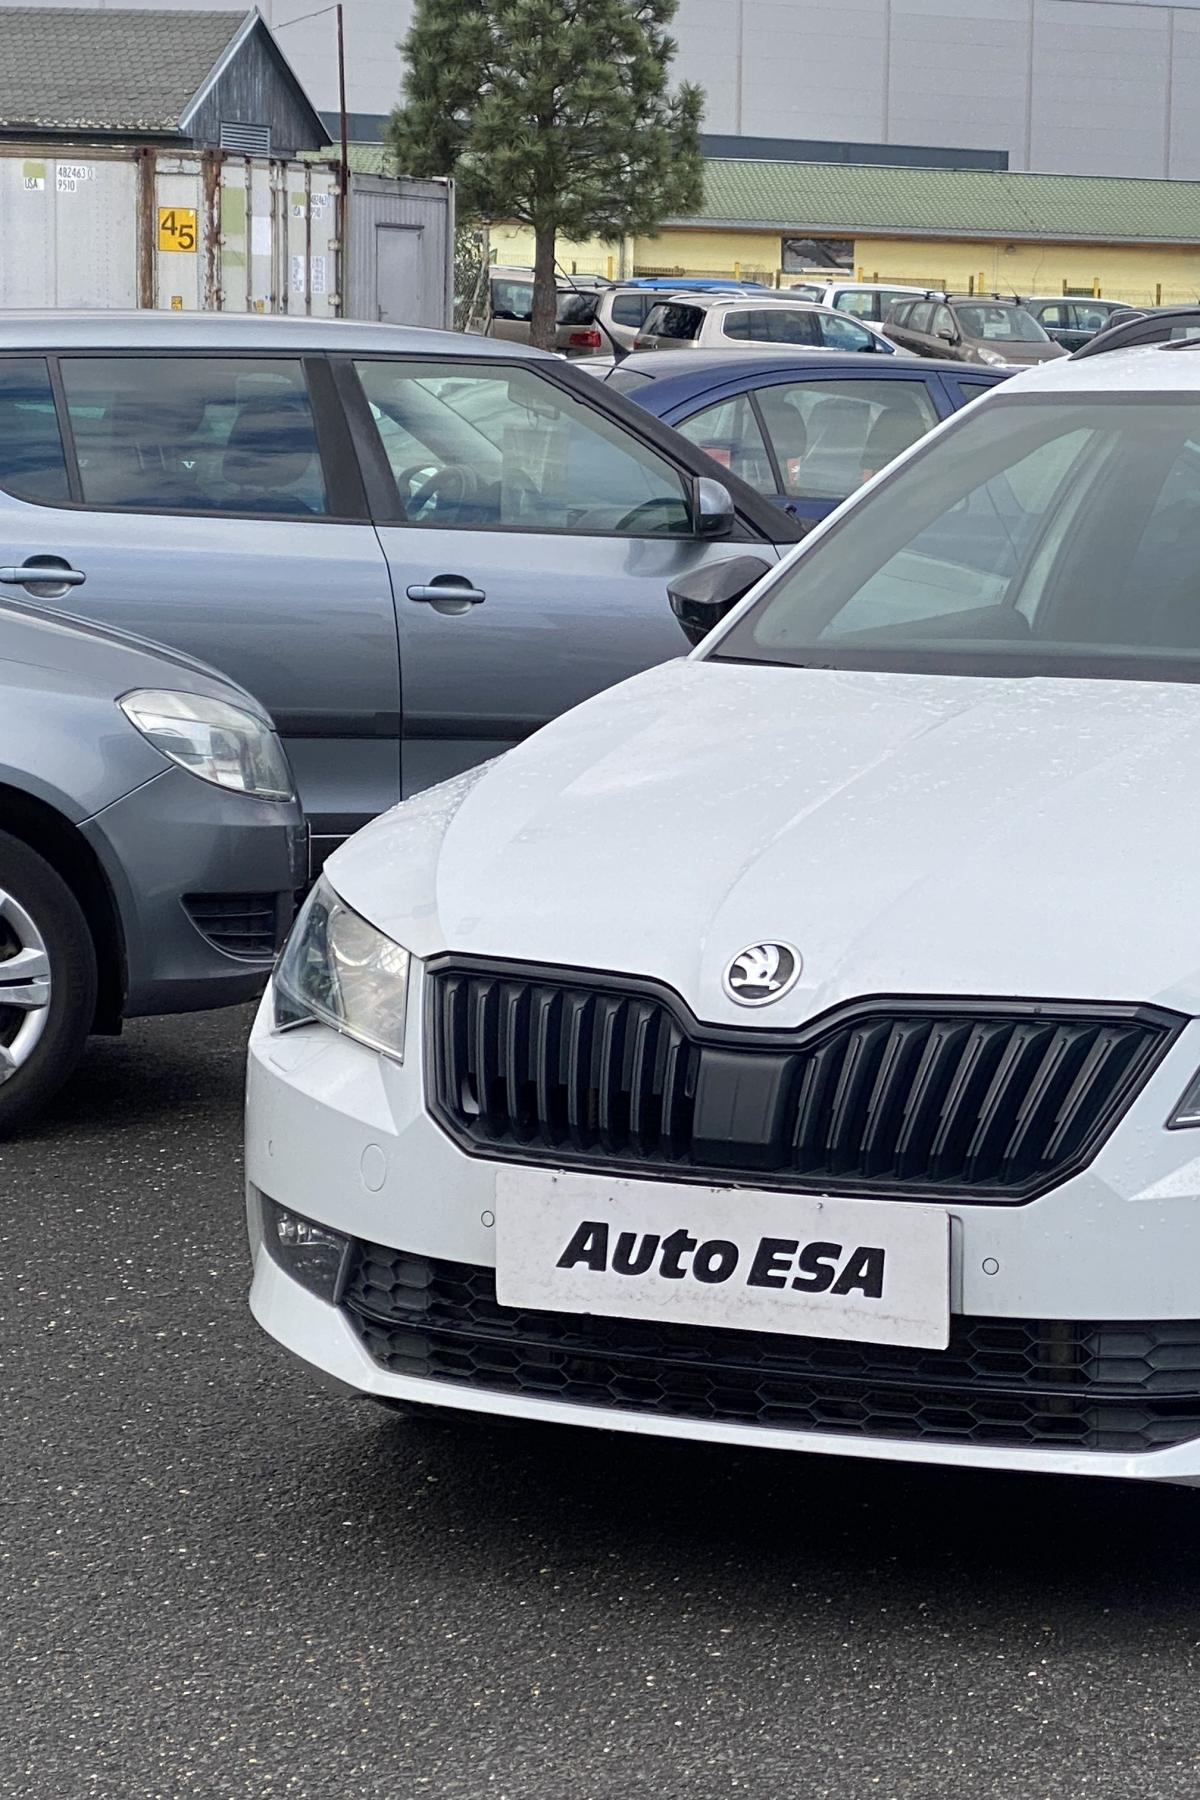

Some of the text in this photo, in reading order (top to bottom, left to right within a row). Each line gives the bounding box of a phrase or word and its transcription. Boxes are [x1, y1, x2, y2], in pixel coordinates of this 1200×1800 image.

[58, 167, 85, 179] 482463
[25, 178, 38, 189] USA
[58, 180, 75, 191] 9510
[161, 211, 194, 249] 45
[556, 1221, 886, 1298] Auto ESA
